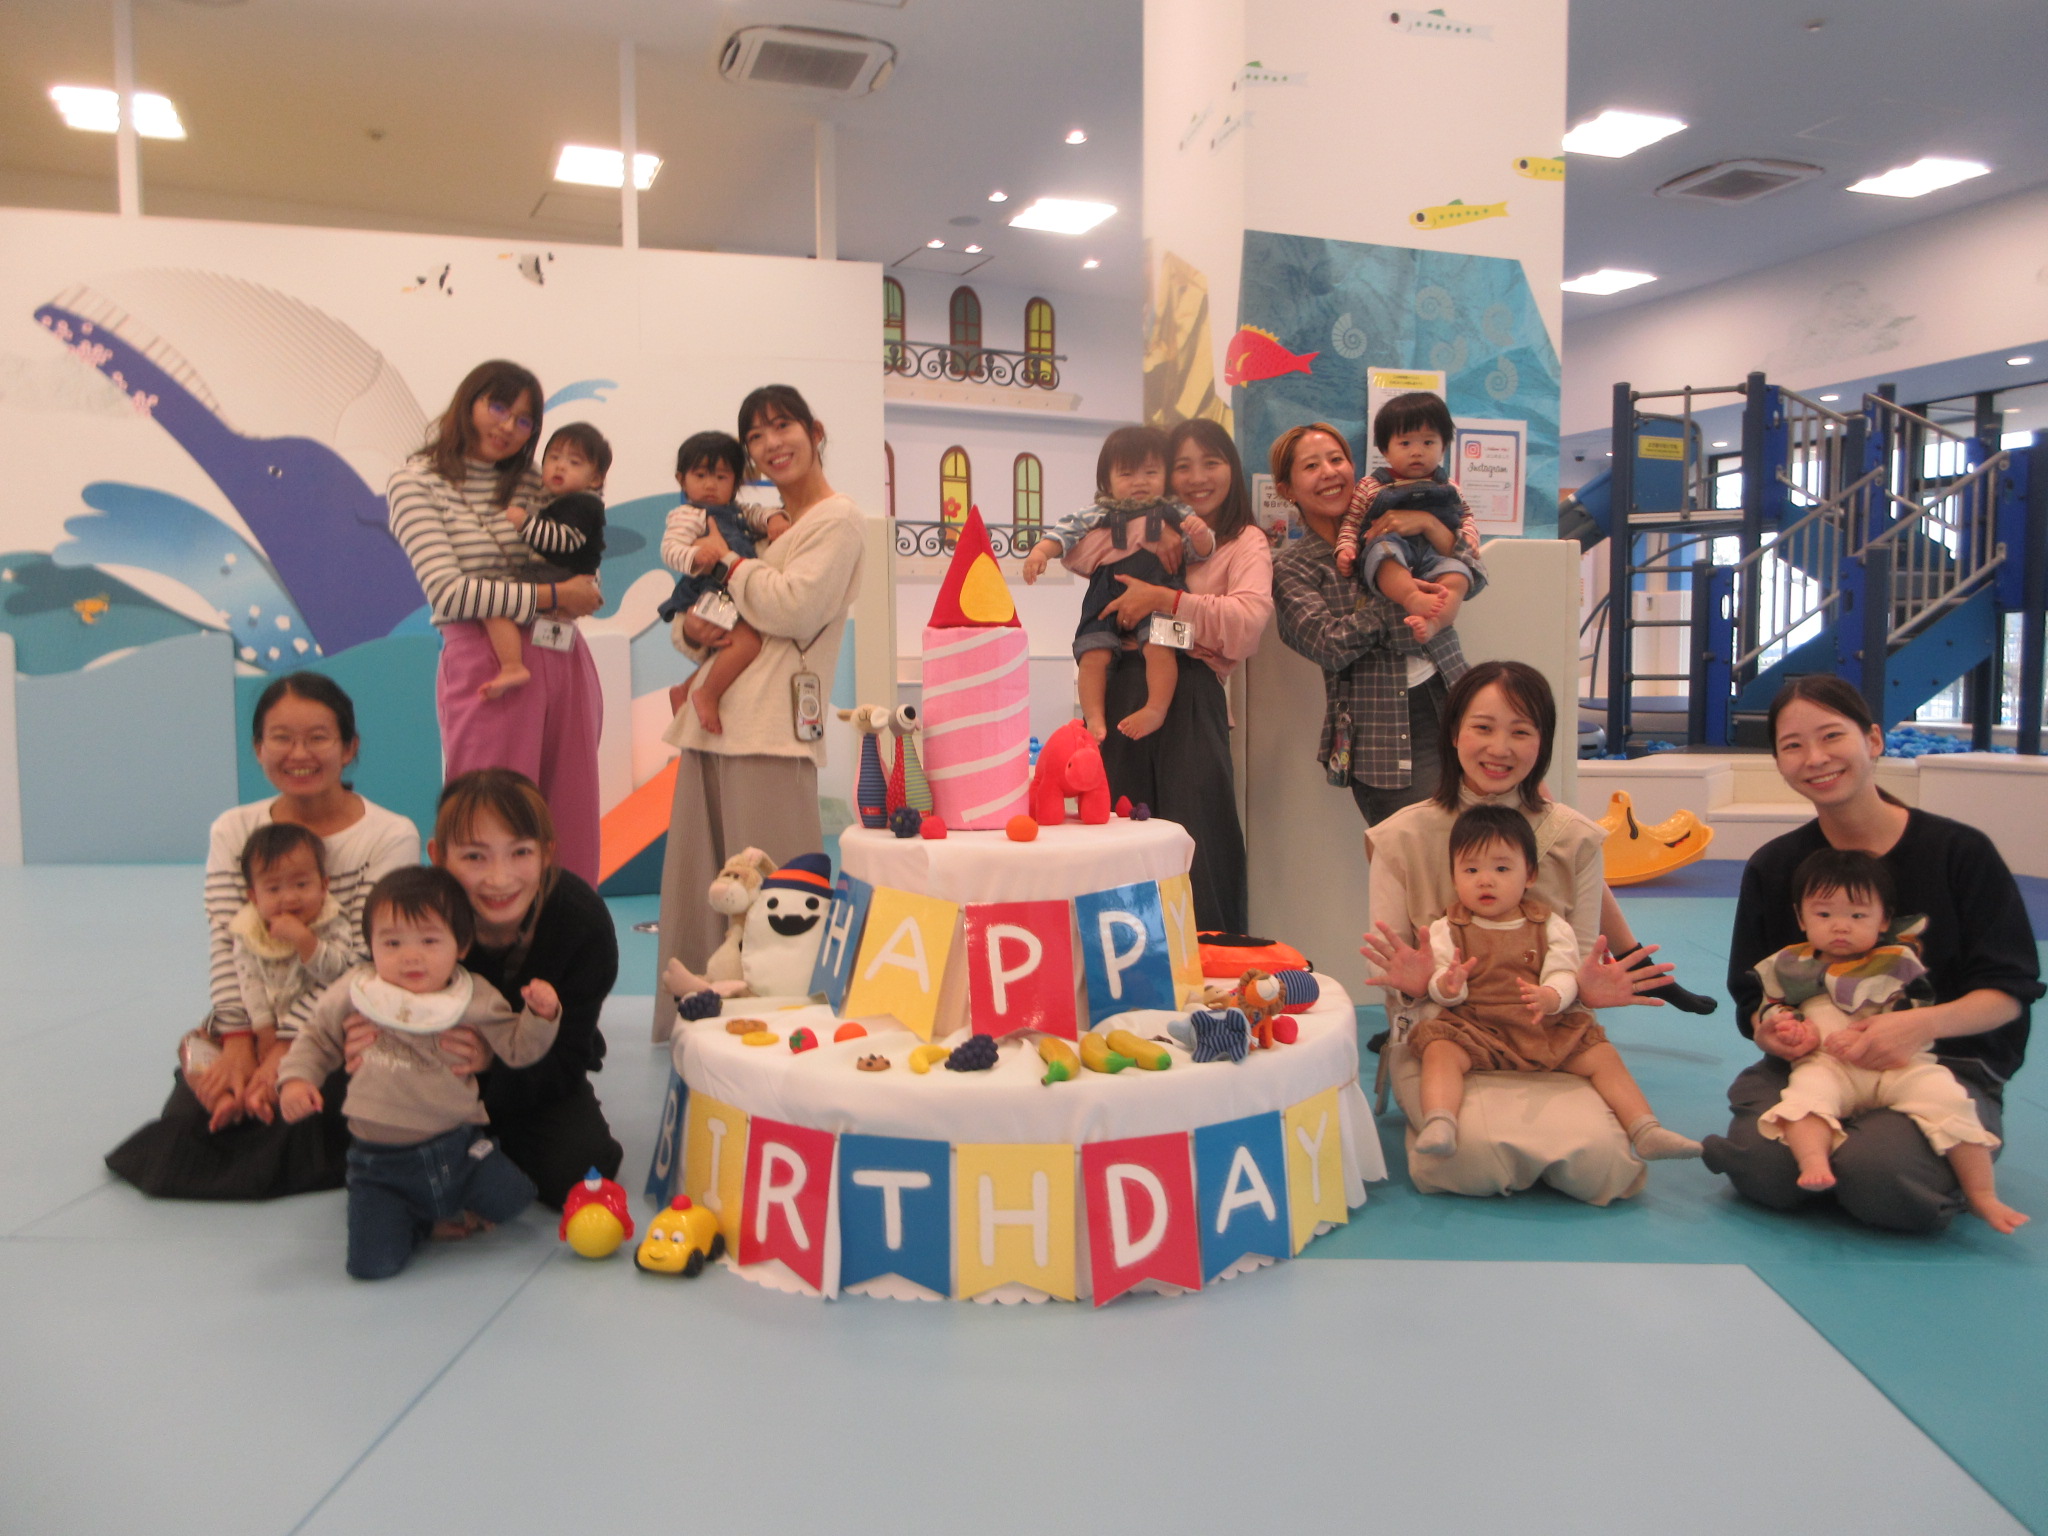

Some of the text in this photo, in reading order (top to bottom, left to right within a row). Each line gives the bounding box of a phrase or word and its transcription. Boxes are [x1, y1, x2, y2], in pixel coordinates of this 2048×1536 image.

[1467, 462, 1508, 478] Instagram
[822, 890, 1188, 1015] HAPPY
[656, 1088, 1328, 1268] BIRTHDAY
